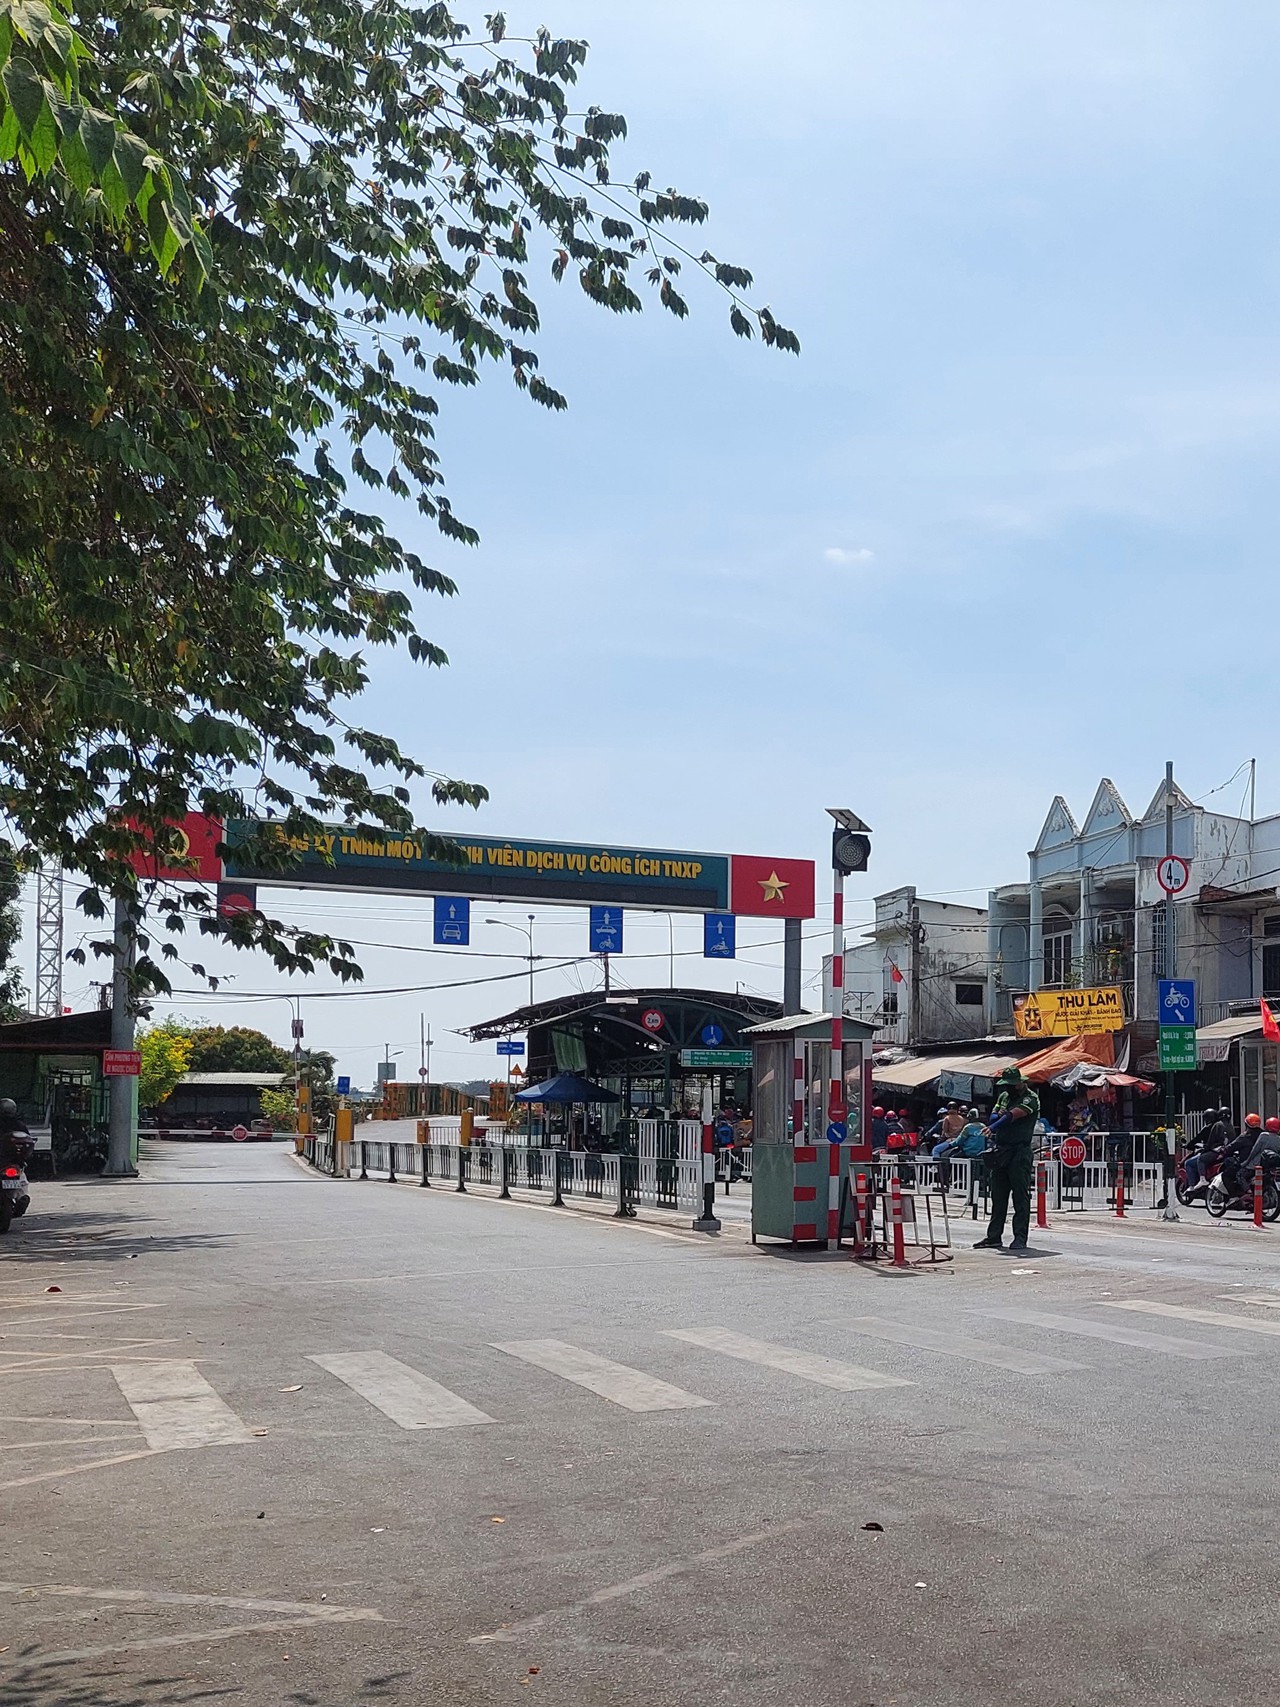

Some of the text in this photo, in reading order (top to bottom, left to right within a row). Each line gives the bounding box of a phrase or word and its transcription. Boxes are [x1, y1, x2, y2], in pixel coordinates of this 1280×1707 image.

[487, 844, 523, 867] VIÊN
[527, 851, 563, 874] DỊCH
[566, 854, 588, 876] VỤ
[590, 851, 631, 874] CÔNG
[634, 853, 660, 876] ÍCH
[663, 860, 702, 879] TNXP
[1057, 990, 1117, 1008] THU LÂM
[234, 1129, 246, 1138] STOP
[1062, 1146, 1083, 1159] STOP
